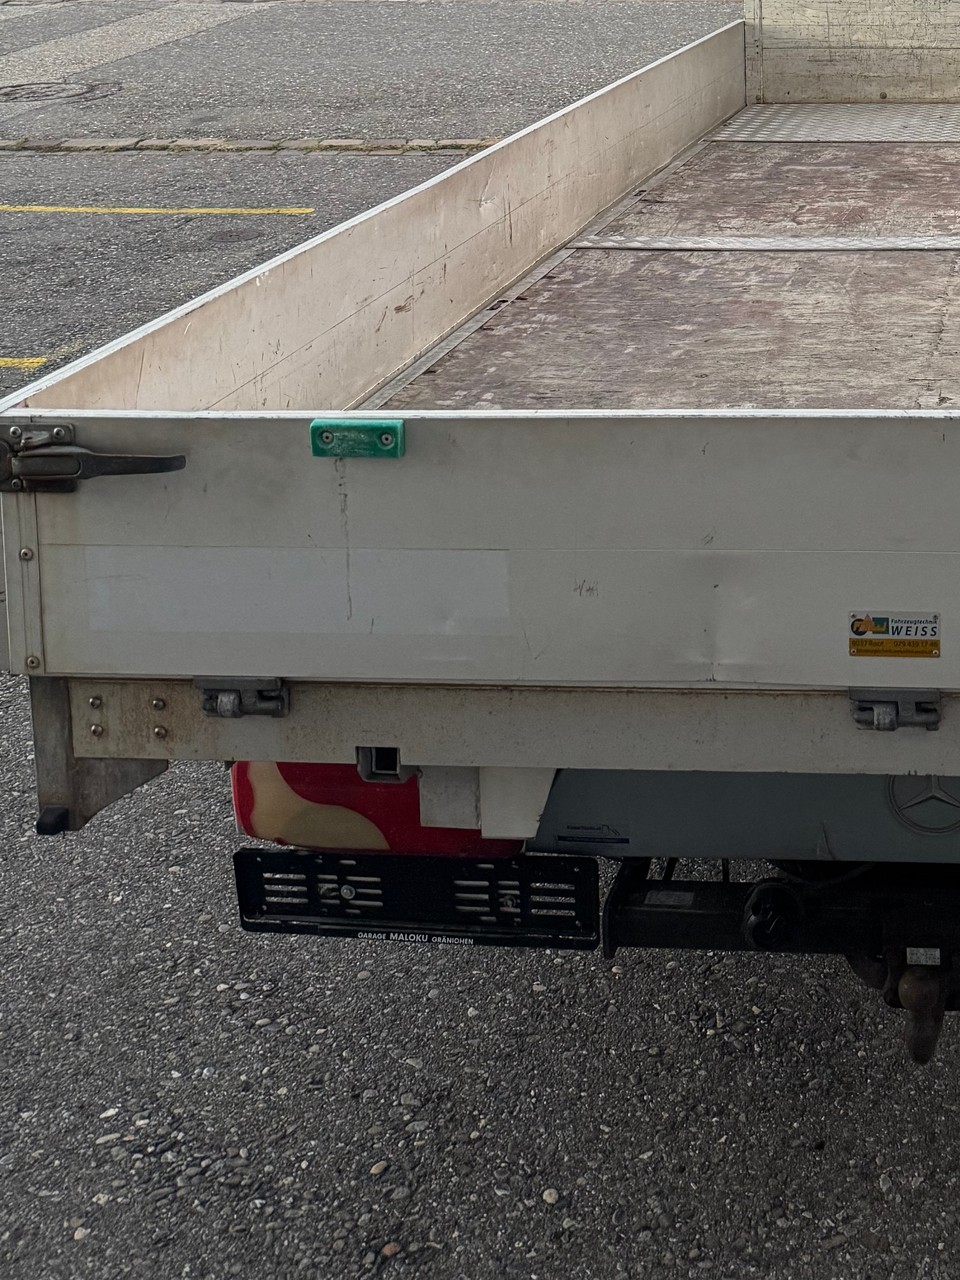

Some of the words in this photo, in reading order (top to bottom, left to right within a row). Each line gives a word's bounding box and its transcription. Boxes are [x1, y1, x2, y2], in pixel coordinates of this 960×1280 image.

[891, 626, 938, 636] WEISS
[357, 932, 387, 940] GARAGE
[389, 933, 429, 942] MALOKU
